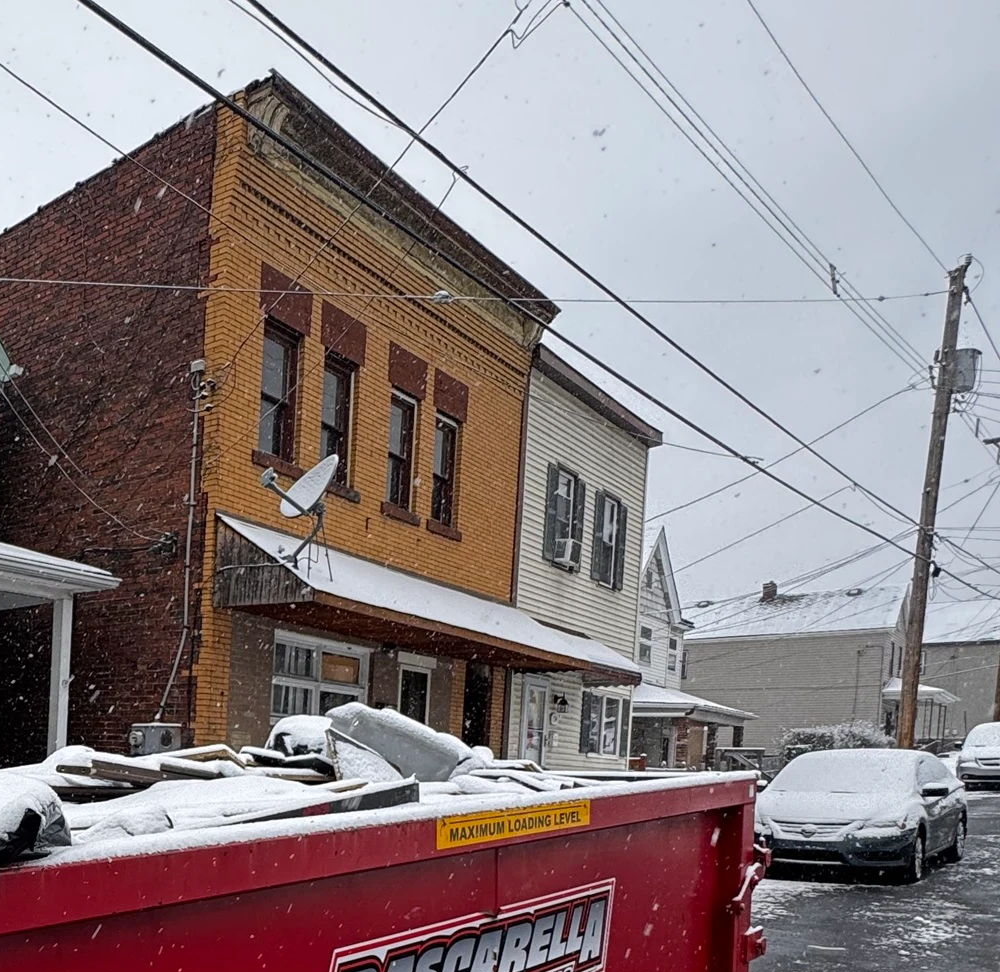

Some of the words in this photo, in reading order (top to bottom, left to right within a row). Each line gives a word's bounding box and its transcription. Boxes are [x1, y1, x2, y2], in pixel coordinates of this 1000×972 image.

[449, 820, 505, 842] MAXIMUM
[507, 813, 552, 833] LOADING
[553, 810, 582, 825] LEVEL
